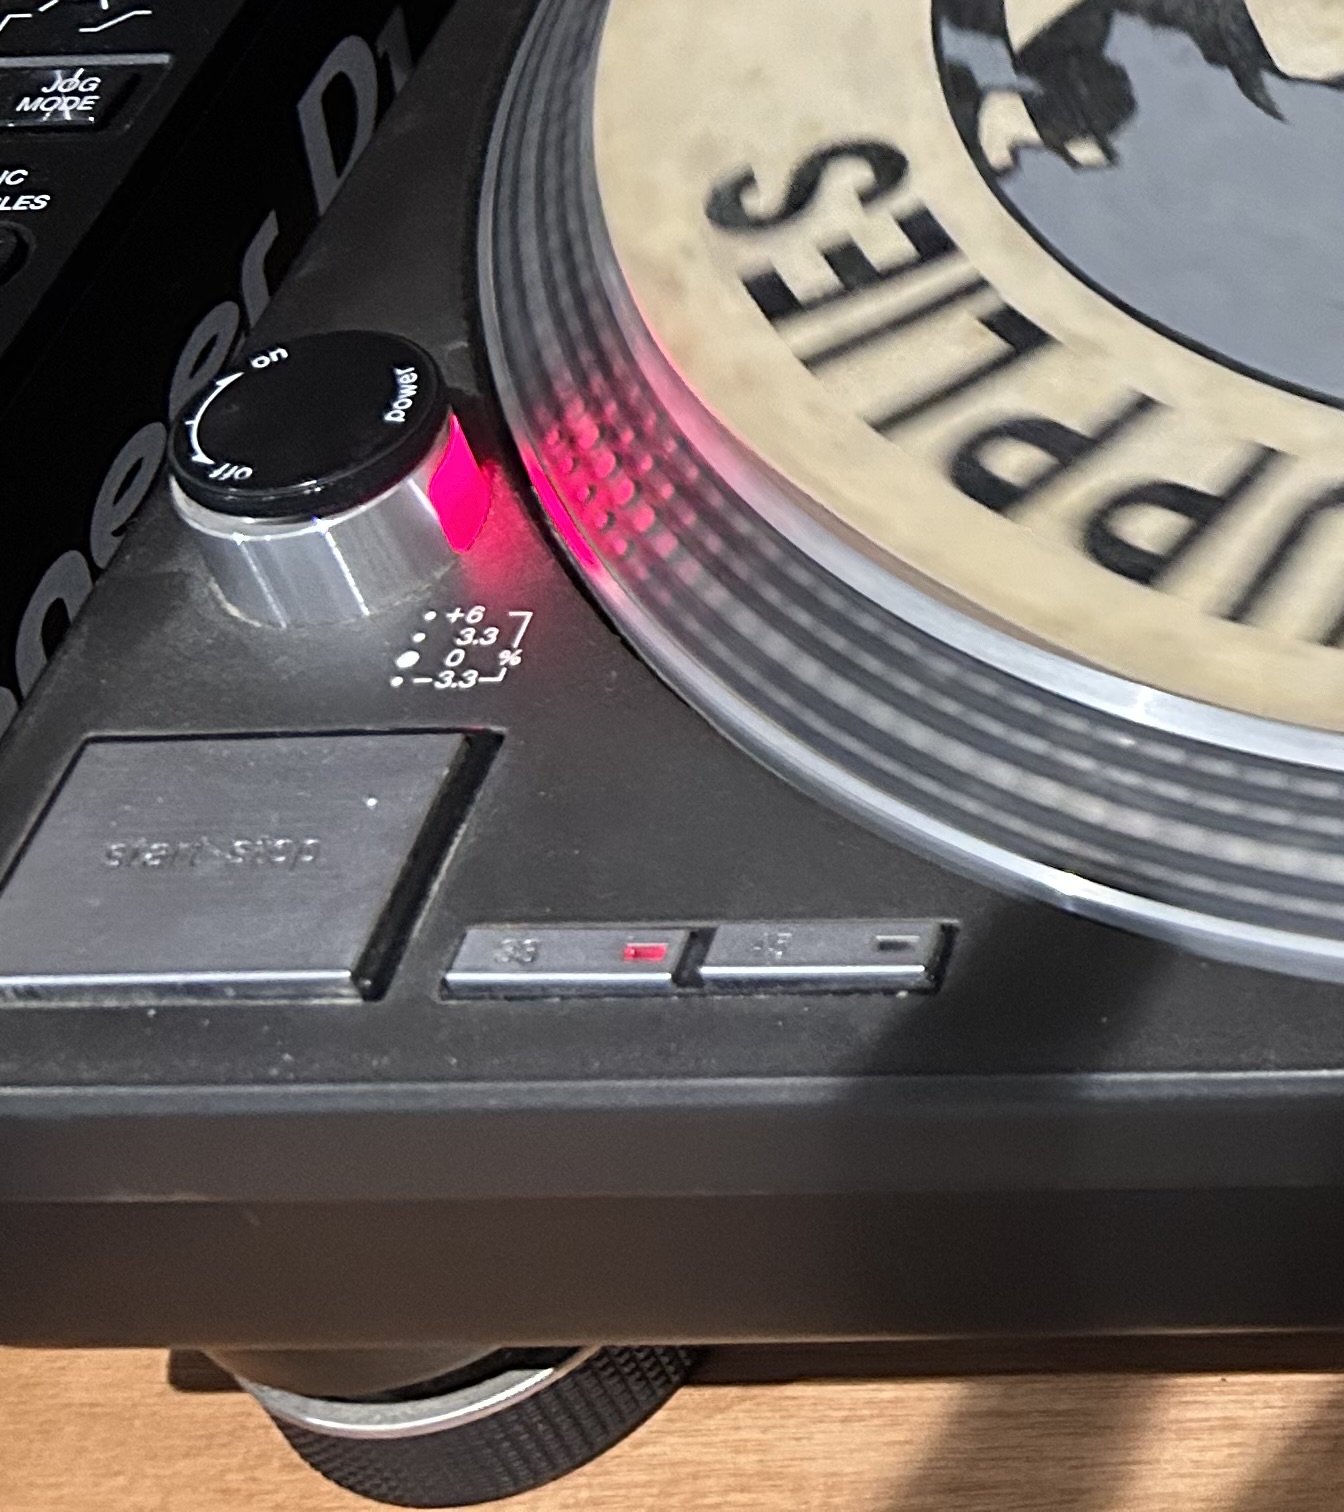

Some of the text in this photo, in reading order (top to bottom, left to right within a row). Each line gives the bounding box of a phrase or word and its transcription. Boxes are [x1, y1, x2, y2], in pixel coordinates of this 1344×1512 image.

[41, 76, 101, 93] JOG
[16, 96, 100, 112] MODE
[251, 347, 288, 369] on
[384, 366, 418, 423] power
[208, 462, 253, 481] off
[446, 605, 486, 623] +6
[455, 627, 500, 645] 3.3
[444, 649, 466, 667] 0
